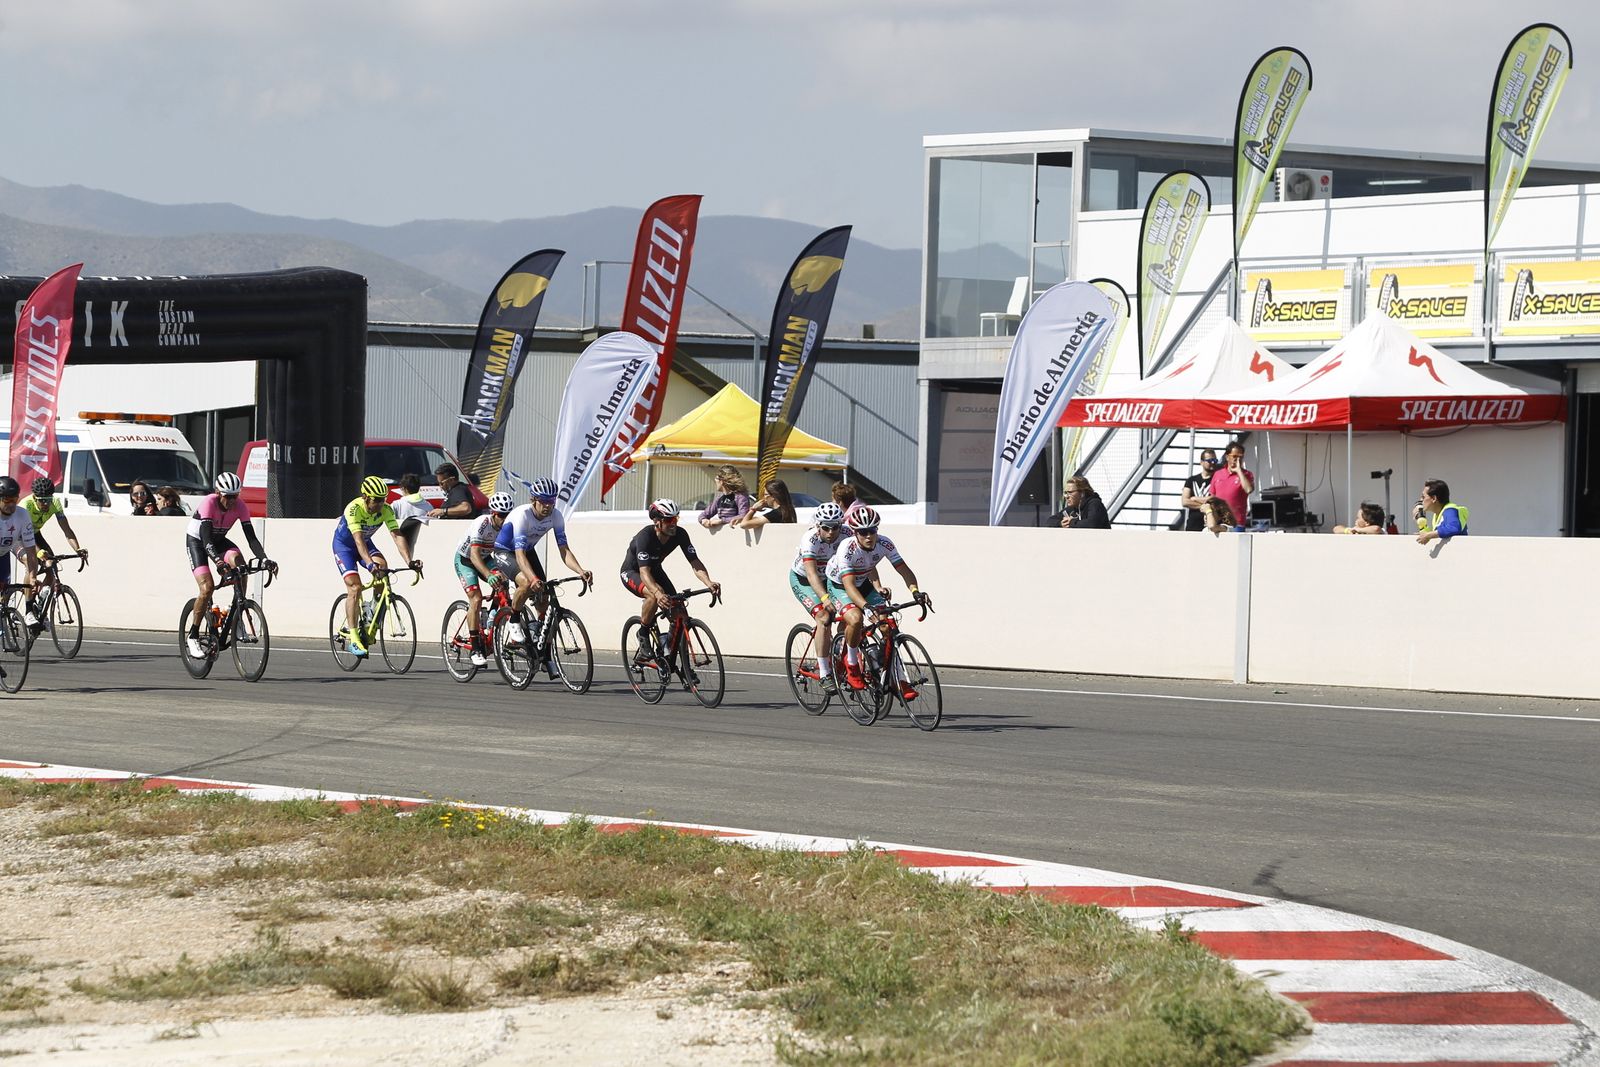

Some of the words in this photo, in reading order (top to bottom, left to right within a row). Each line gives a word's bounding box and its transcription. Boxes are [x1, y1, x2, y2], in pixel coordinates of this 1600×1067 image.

[159, 300, 176, 311] THE
[159, 311, 195, 323] CUSTOM
[159, 323, 185, 334] WEAR
[158, 334, 201, 346] COMPANY
[471, 328, 516, 431] TRACKMAN
[766, 315, 810, 425] TRACKMAN
[20, 306, 59, 478] ARISTIDES
[1000, 405, 1041, 465] Diario
[1034, 382, 1055, 405] de
[1046, 310, 1099, 384] Almería
[1083, 402, 1164, 423] SPECIALIZED
[1225, 403, 1318, 425] SPECIALIZED
[1397, 400, 1525, 420] SPECIALIZED
[557, 449, 593, 503] Diario
[585, 427, 605, 449] de
[595, 358, 643, 429] Almería
[308, 446, 360, 465] GOBIK
